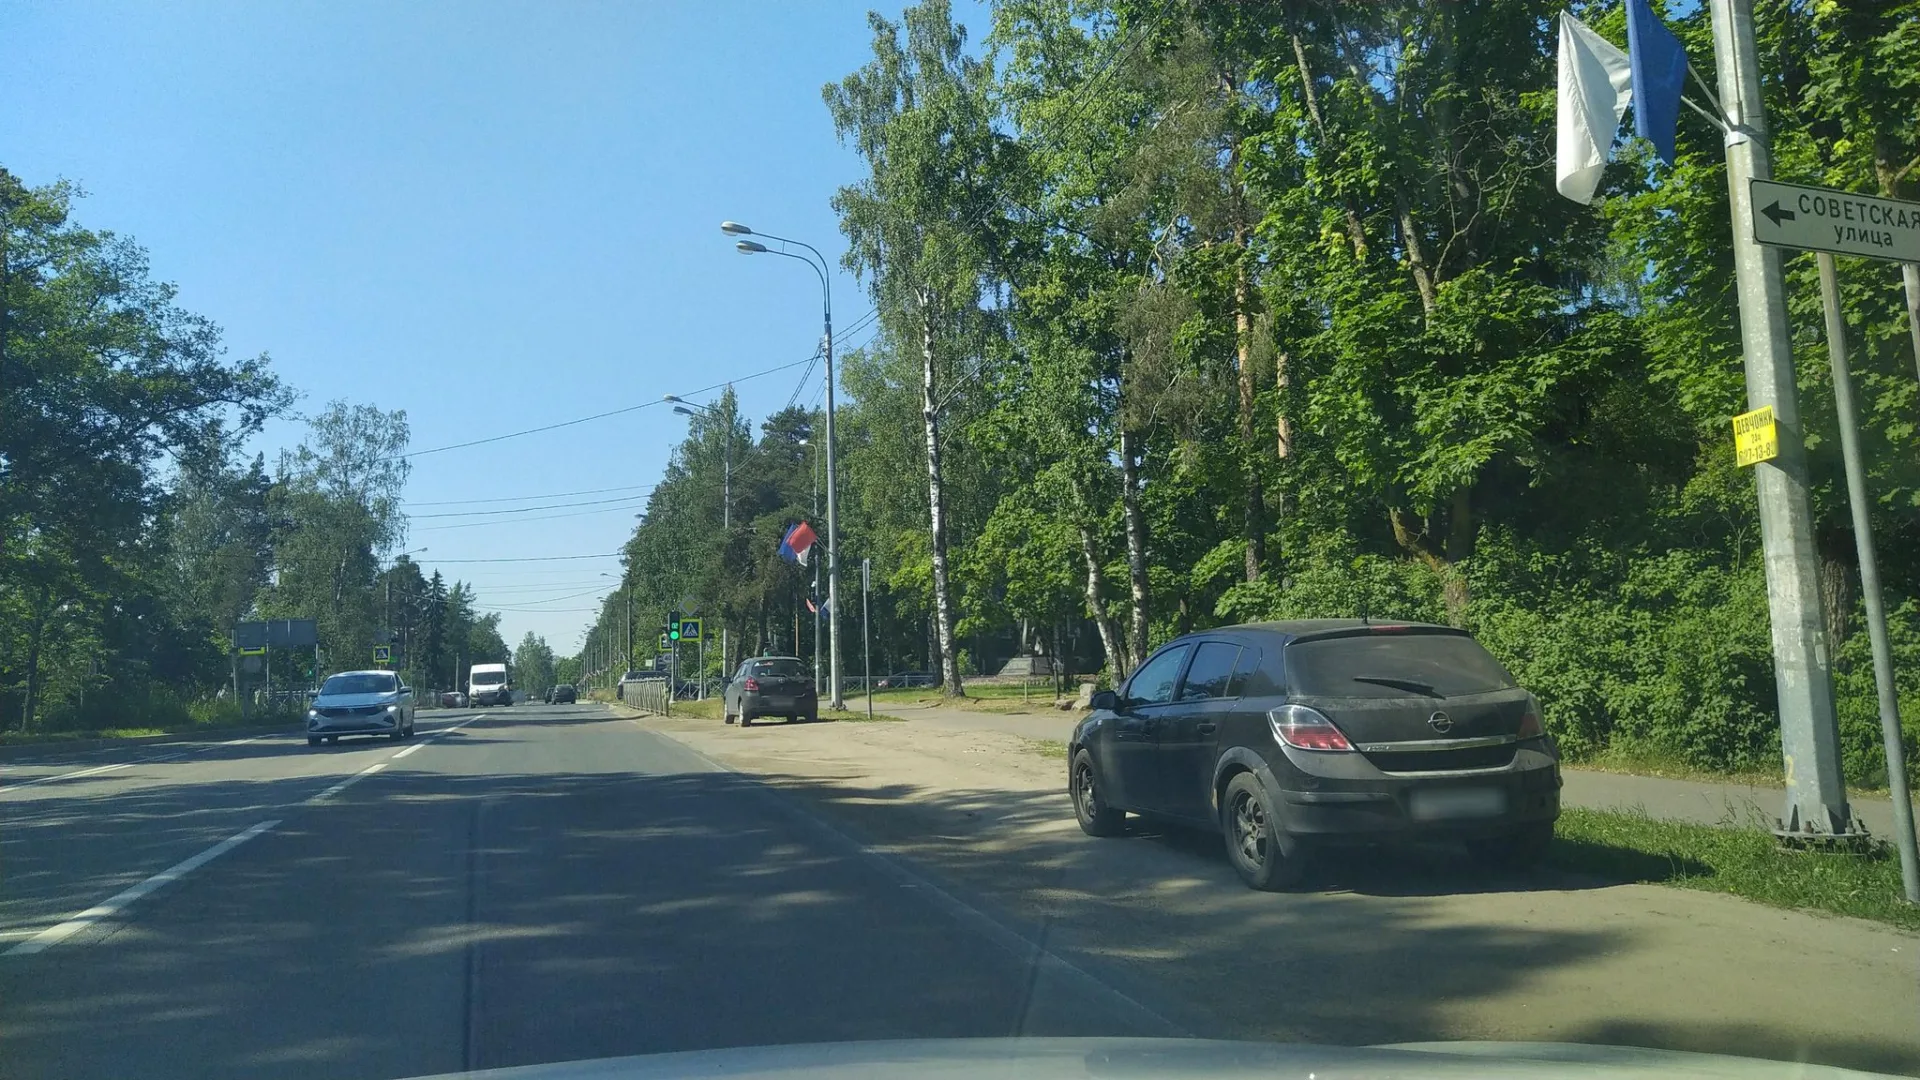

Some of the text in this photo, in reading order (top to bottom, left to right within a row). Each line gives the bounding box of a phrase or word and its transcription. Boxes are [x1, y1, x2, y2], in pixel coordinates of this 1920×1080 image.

[1798, 193, 1920, 229] СОВЕТСКАЯ
[1834, 224, 1893, 248] улица
[1735, 409, 1774, 437] ДЕВЧОНКИ
